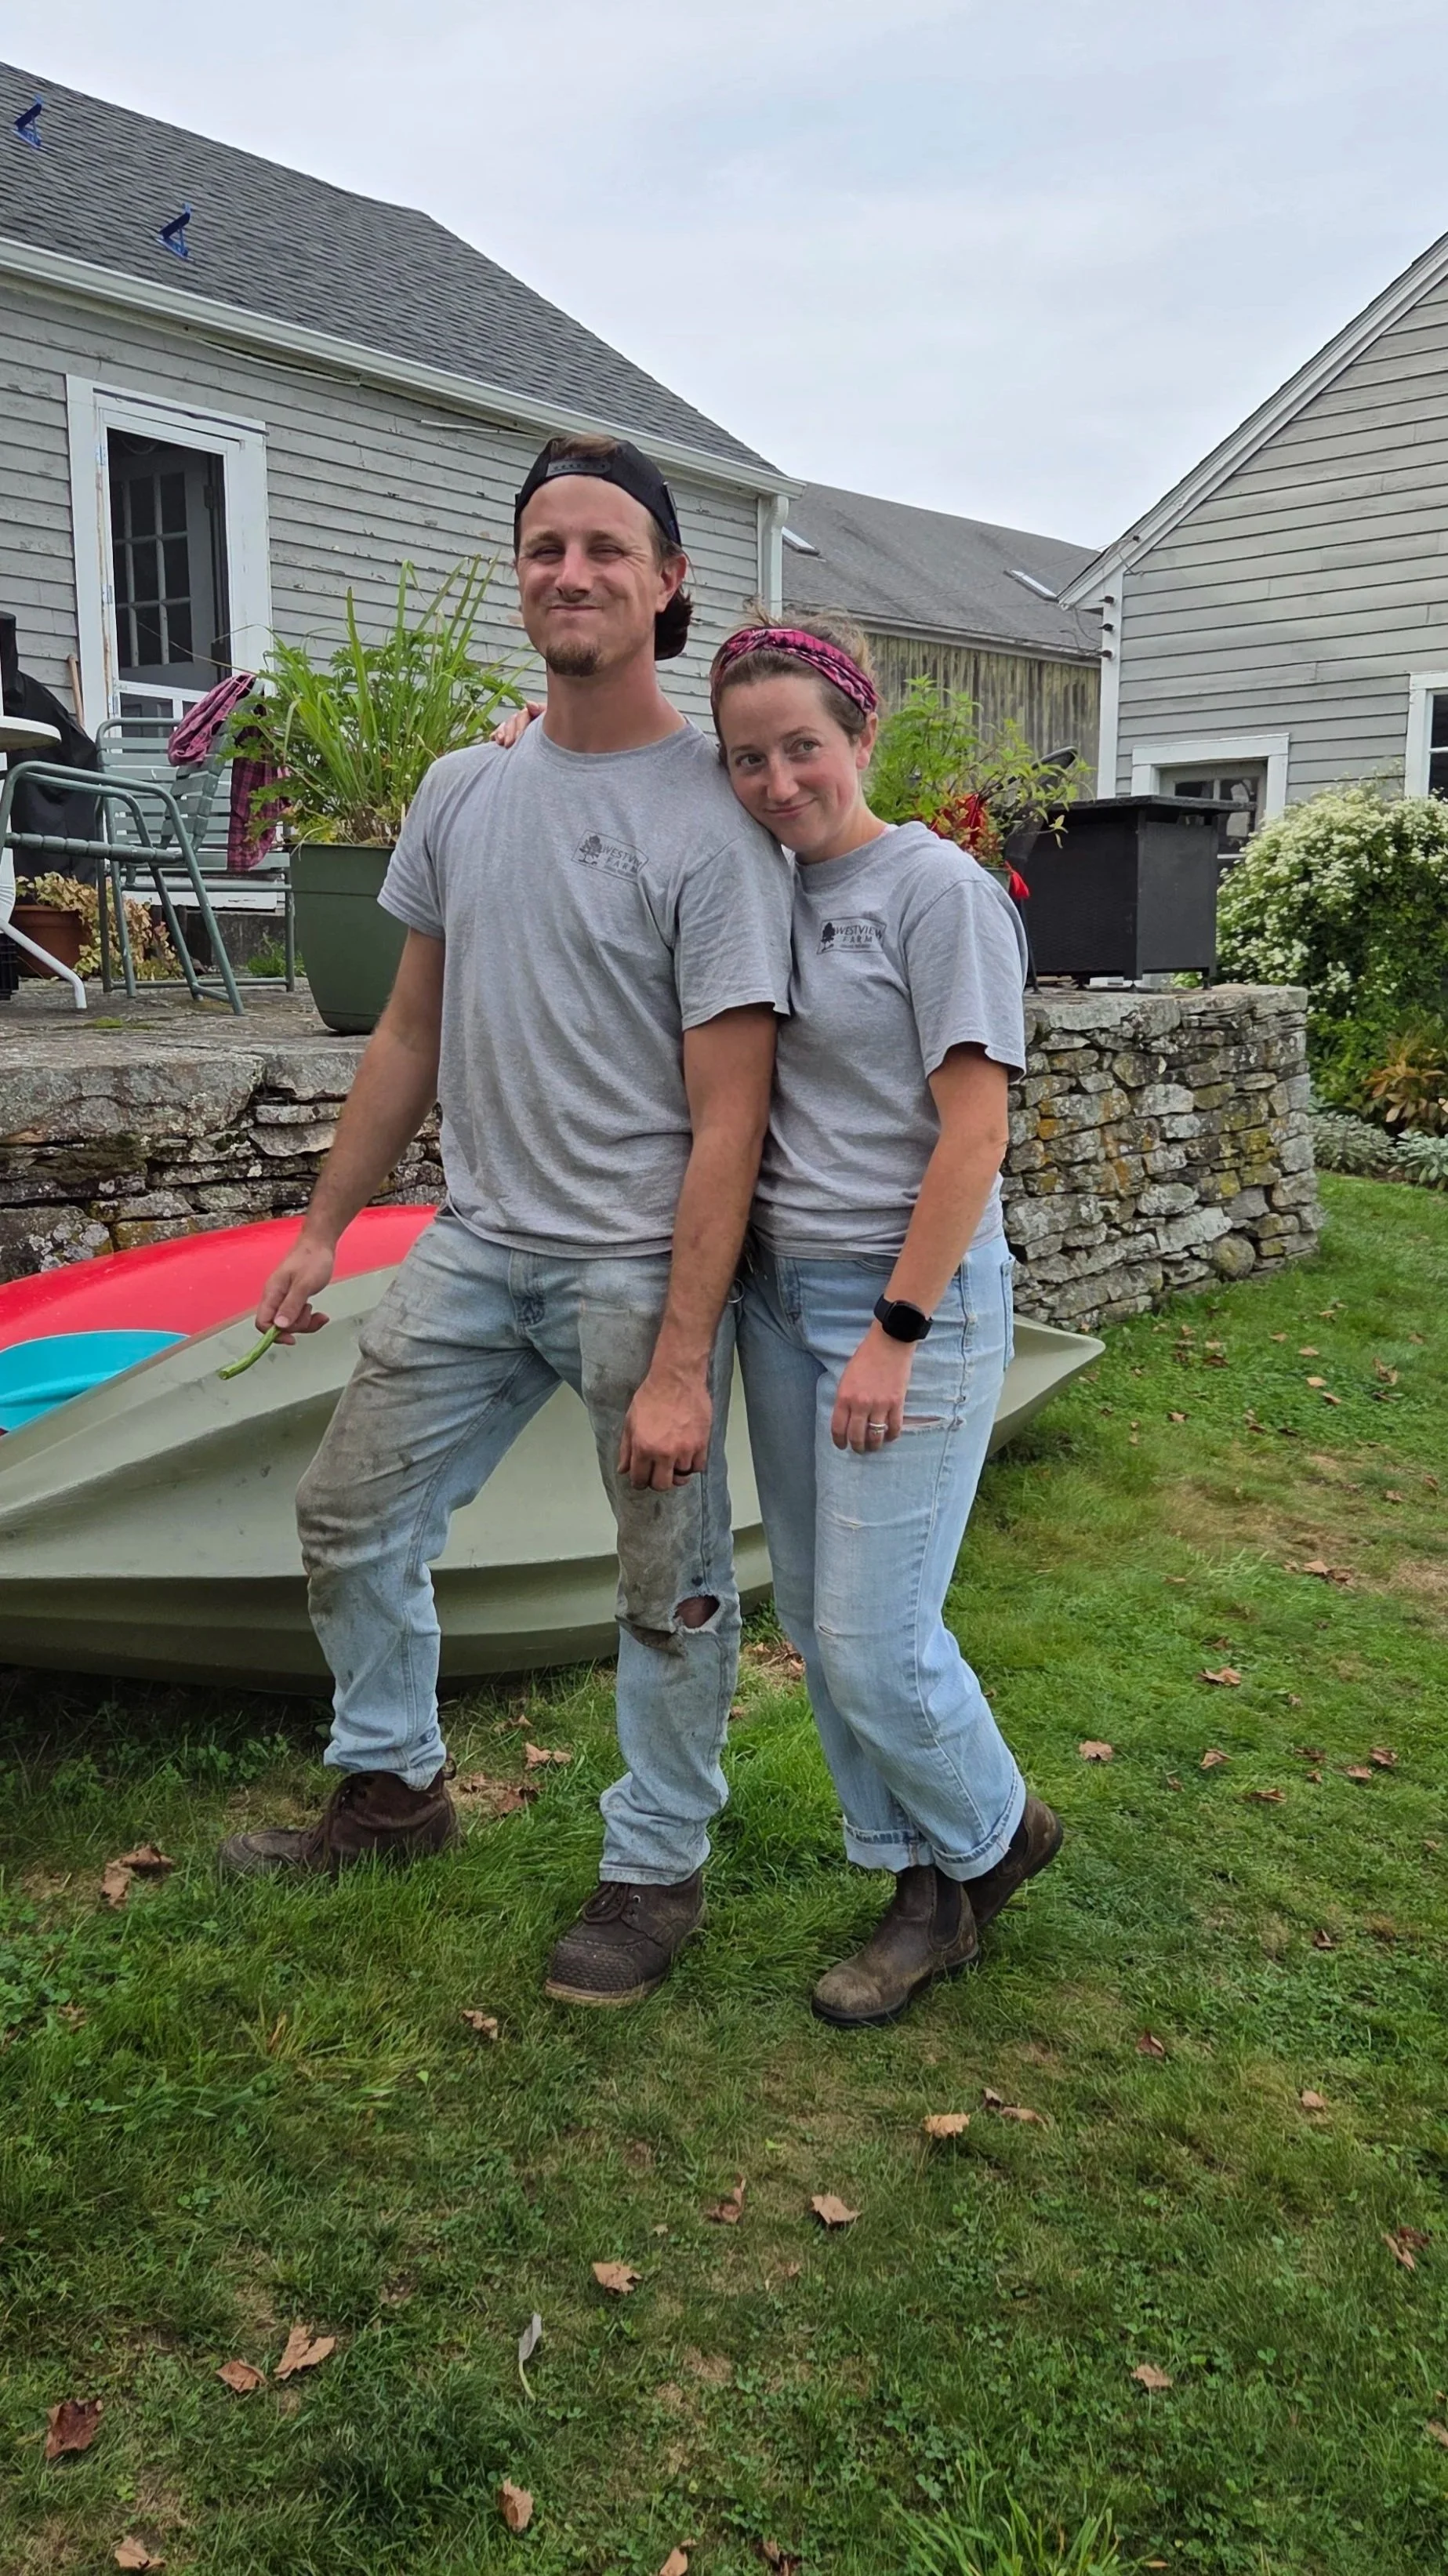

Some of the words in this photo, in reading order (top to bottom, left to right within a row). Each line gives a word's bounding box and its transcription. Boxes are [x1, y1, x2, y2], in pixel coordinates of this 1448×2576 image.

[601, 845, 642, 867] WESTV
[834, 925, 882, 939] WESTVIEW
[843, 935, 873, 943] FARM
